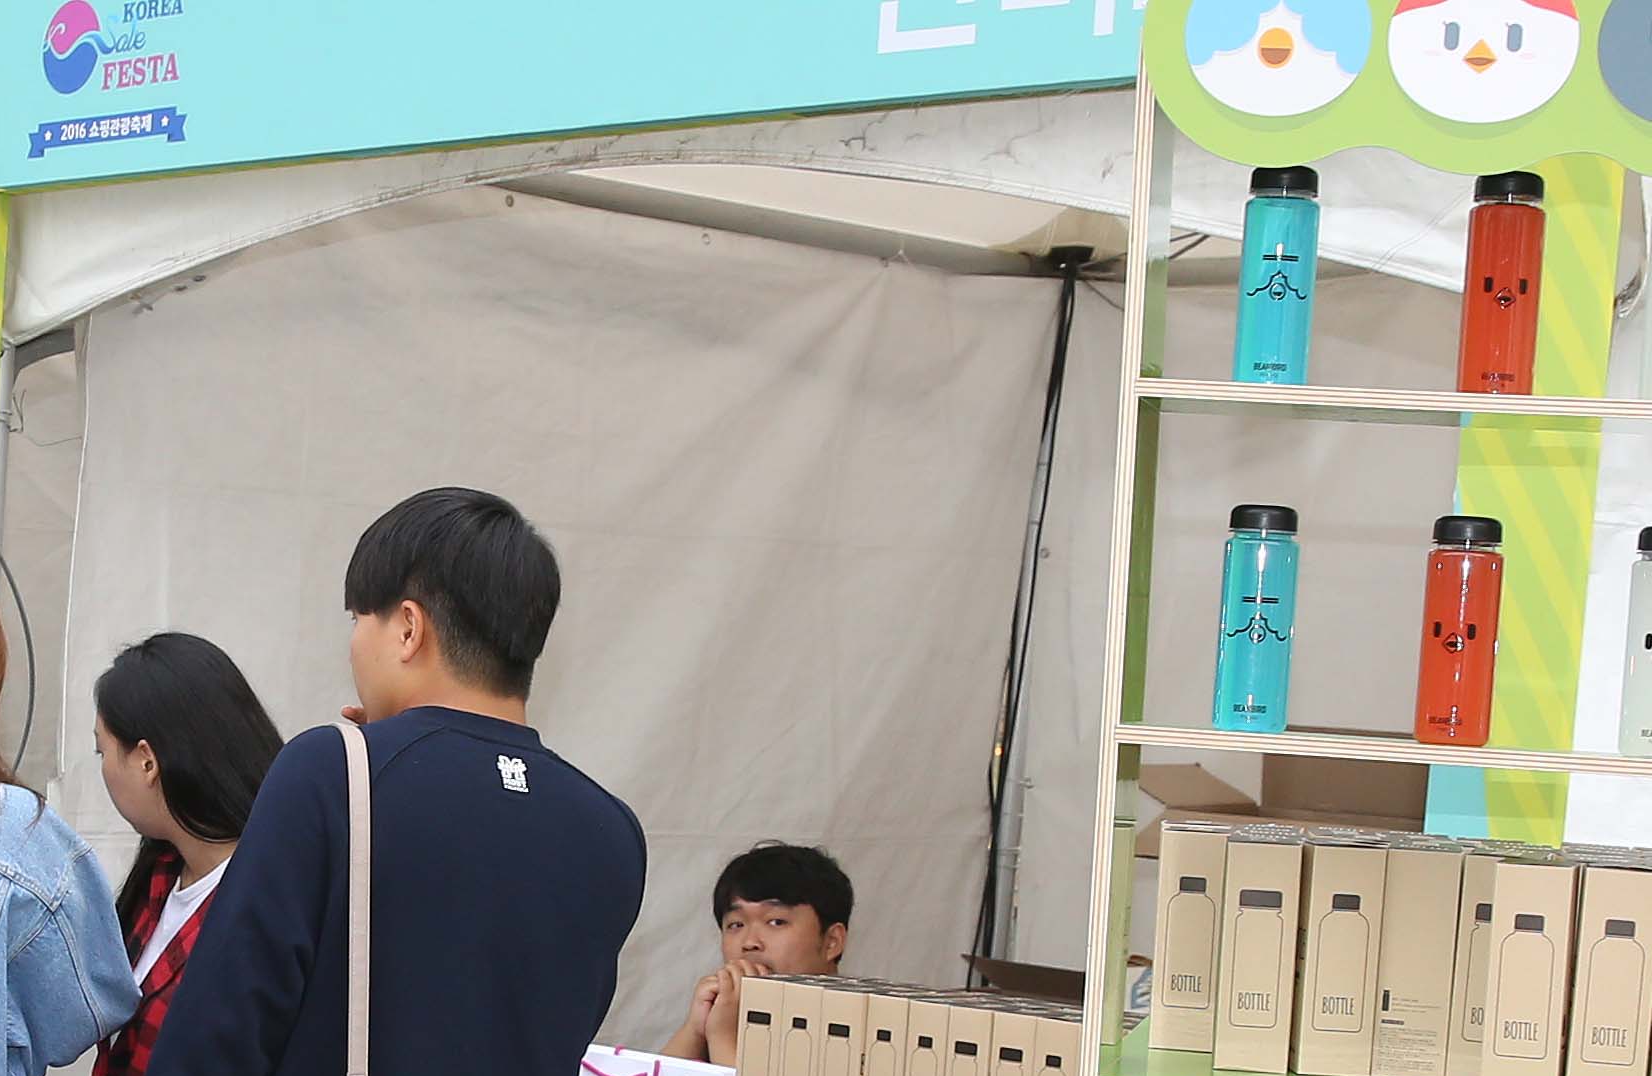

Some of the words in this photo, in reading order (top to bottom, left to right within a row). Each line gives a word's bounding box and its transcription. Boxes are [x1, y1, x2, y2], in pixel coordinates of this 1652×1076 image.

[101, 53, 180, 91] FESTA
[60, 123, 87, 141] 2016
[88, 113, 154, 138] 쇼핑관광축제
[1170, 974, 1203, 994] BOTTLE
[1236, 991, 1272, 1013] BOTTLE
[1320, 995, 1356, 1017] BOTTLE
[1502, 1020, 1539, 1043] BOTTLE
[1590, 1026, 1628, 1049] BOTTLE
